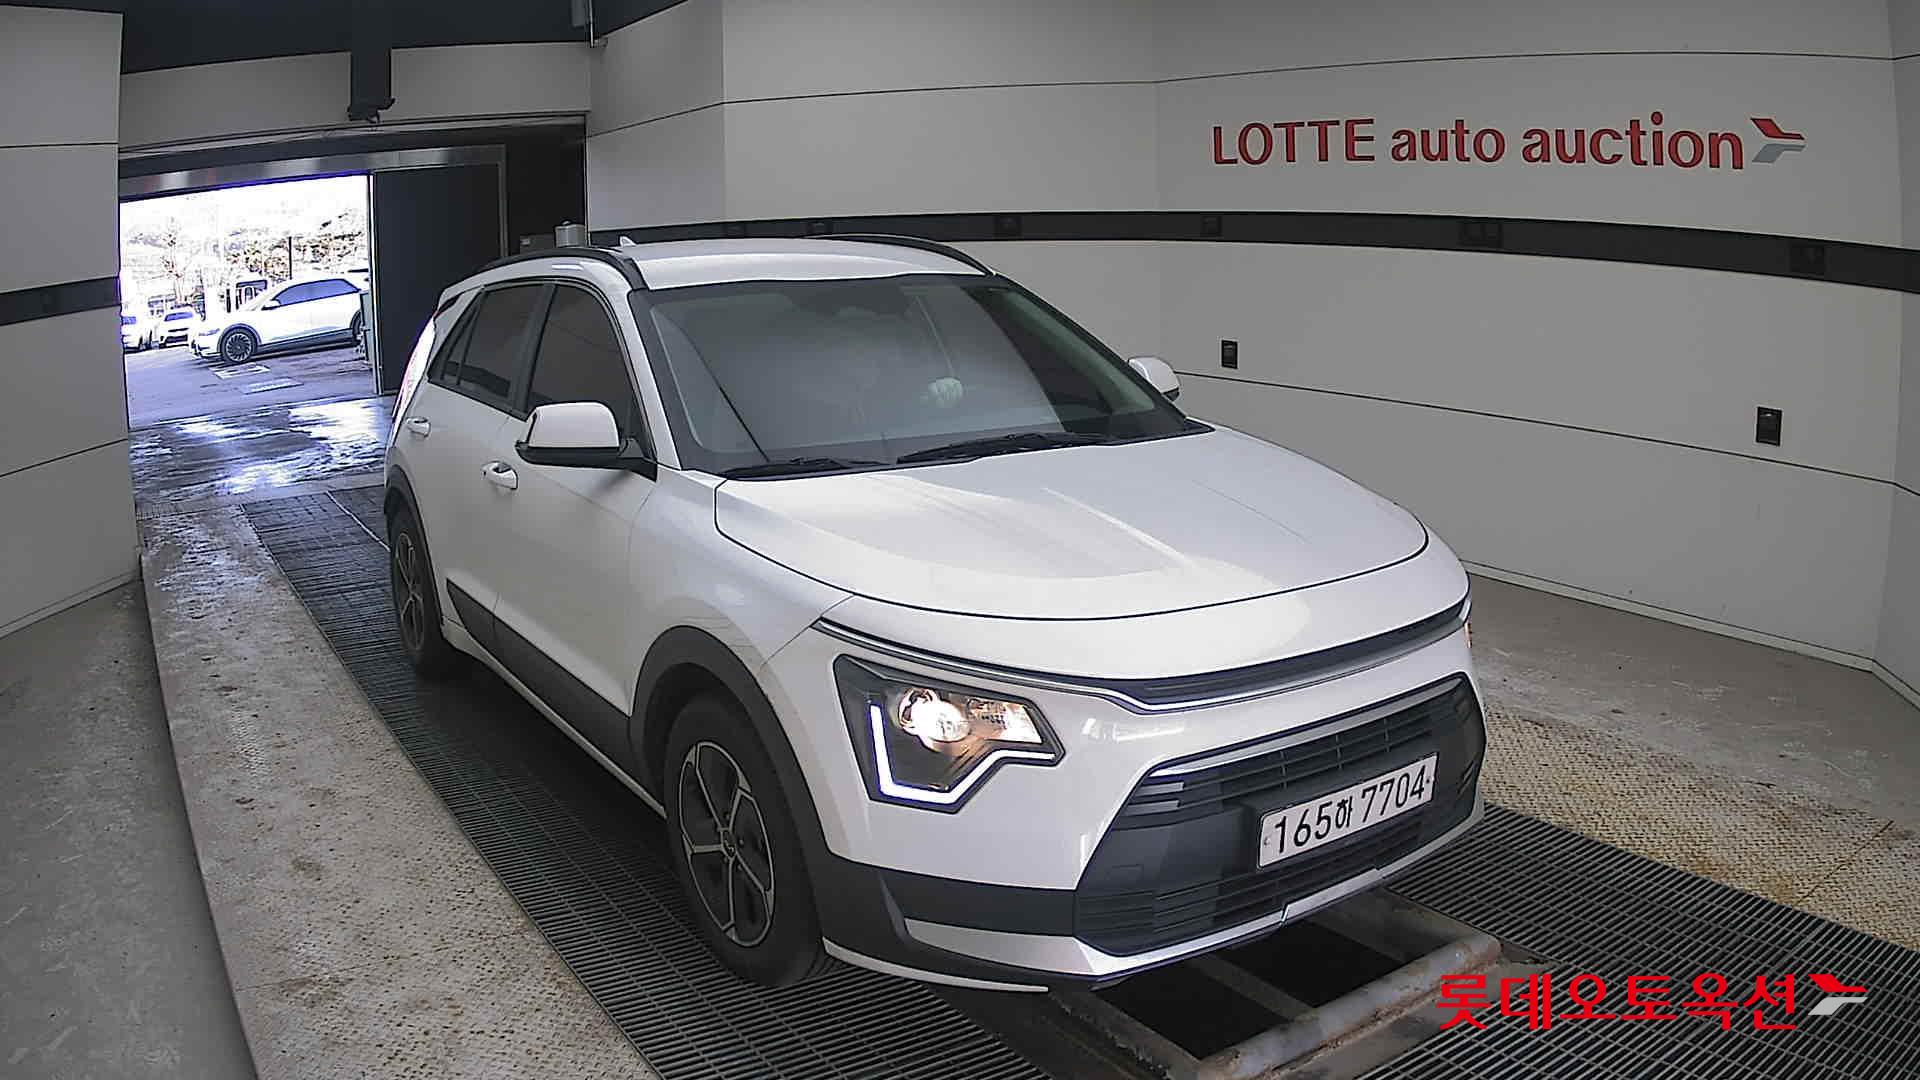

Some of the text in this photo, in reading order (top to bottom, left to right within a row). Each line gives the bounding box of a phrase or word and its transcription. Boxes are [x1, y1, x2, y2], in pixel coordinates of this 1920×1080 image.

[1213, 111, 1744, 170] LOTTE auto auction
[1274, 764, 1426, 854] 165하 7704
